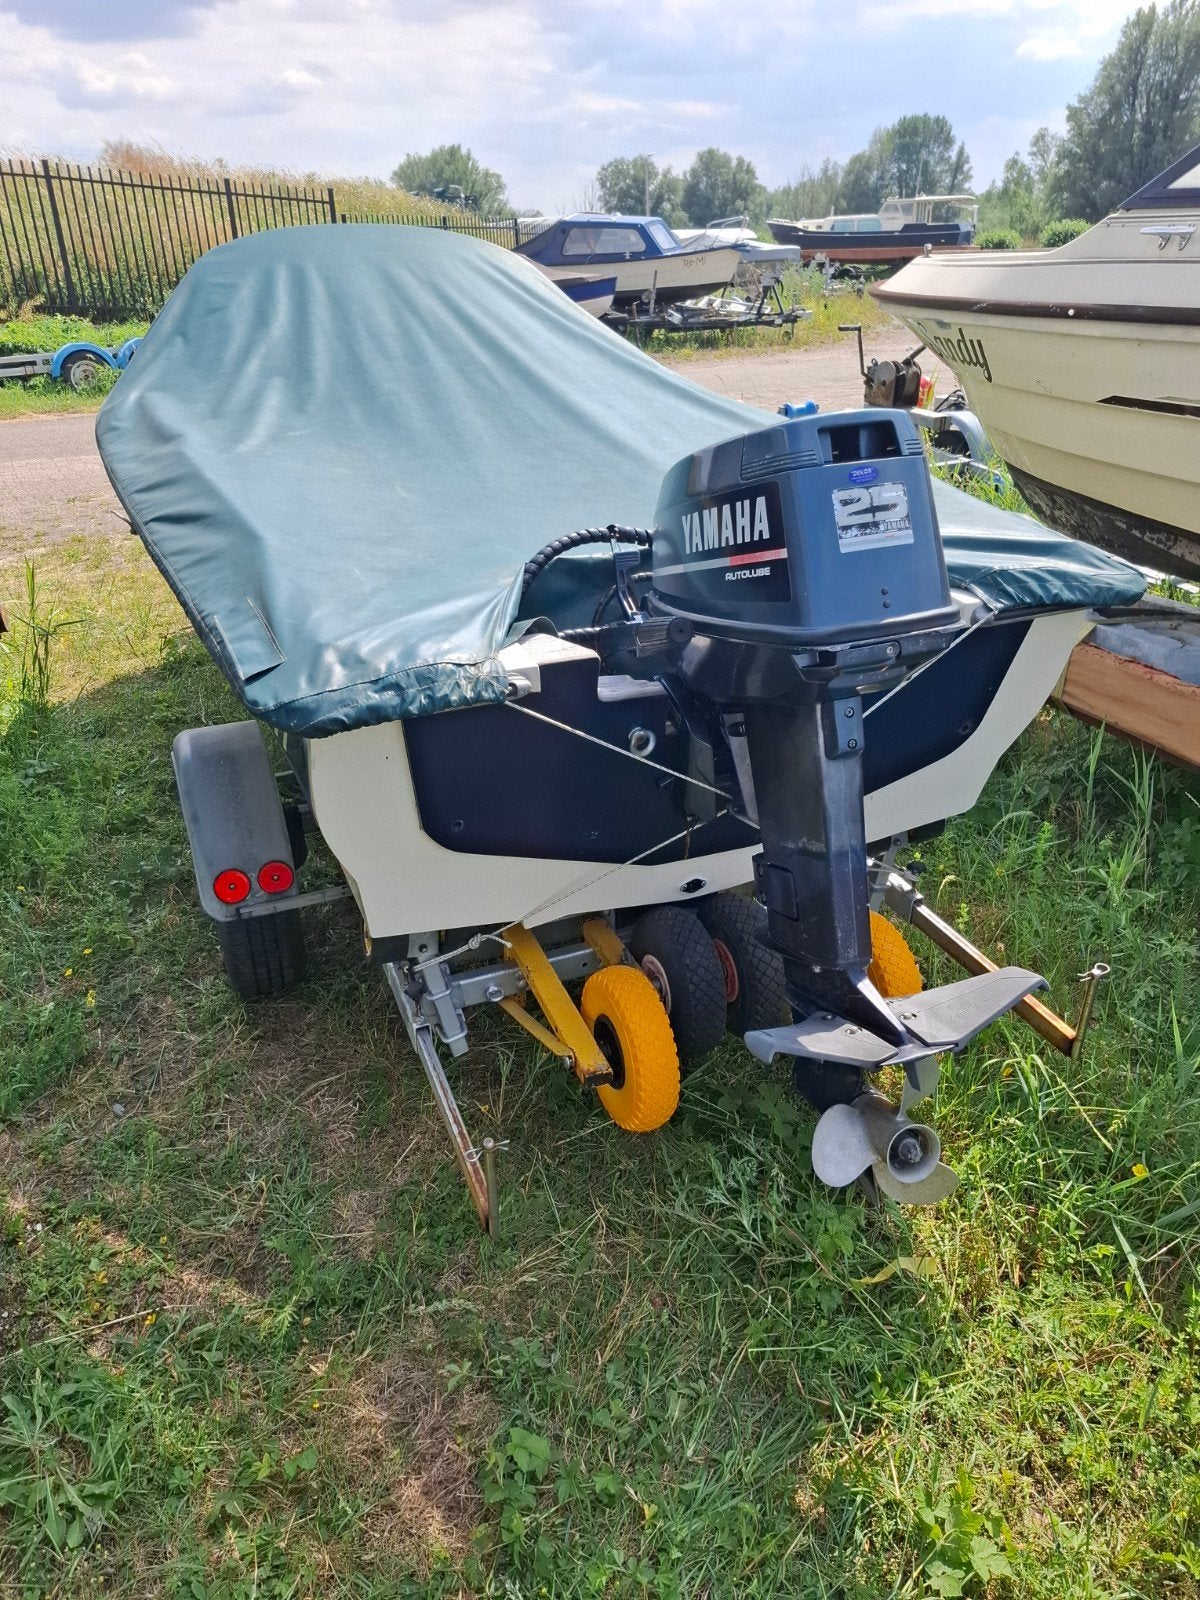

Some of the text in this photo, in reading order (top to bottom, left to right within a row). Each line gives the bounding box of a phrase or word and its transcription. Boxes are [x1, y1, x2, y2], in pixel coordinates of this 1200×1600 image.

[681, 496, 770, 555] YAMAHA
[835, 483, 908, 527] 25
[725, 566, 771, 581] AUTOLUBE
